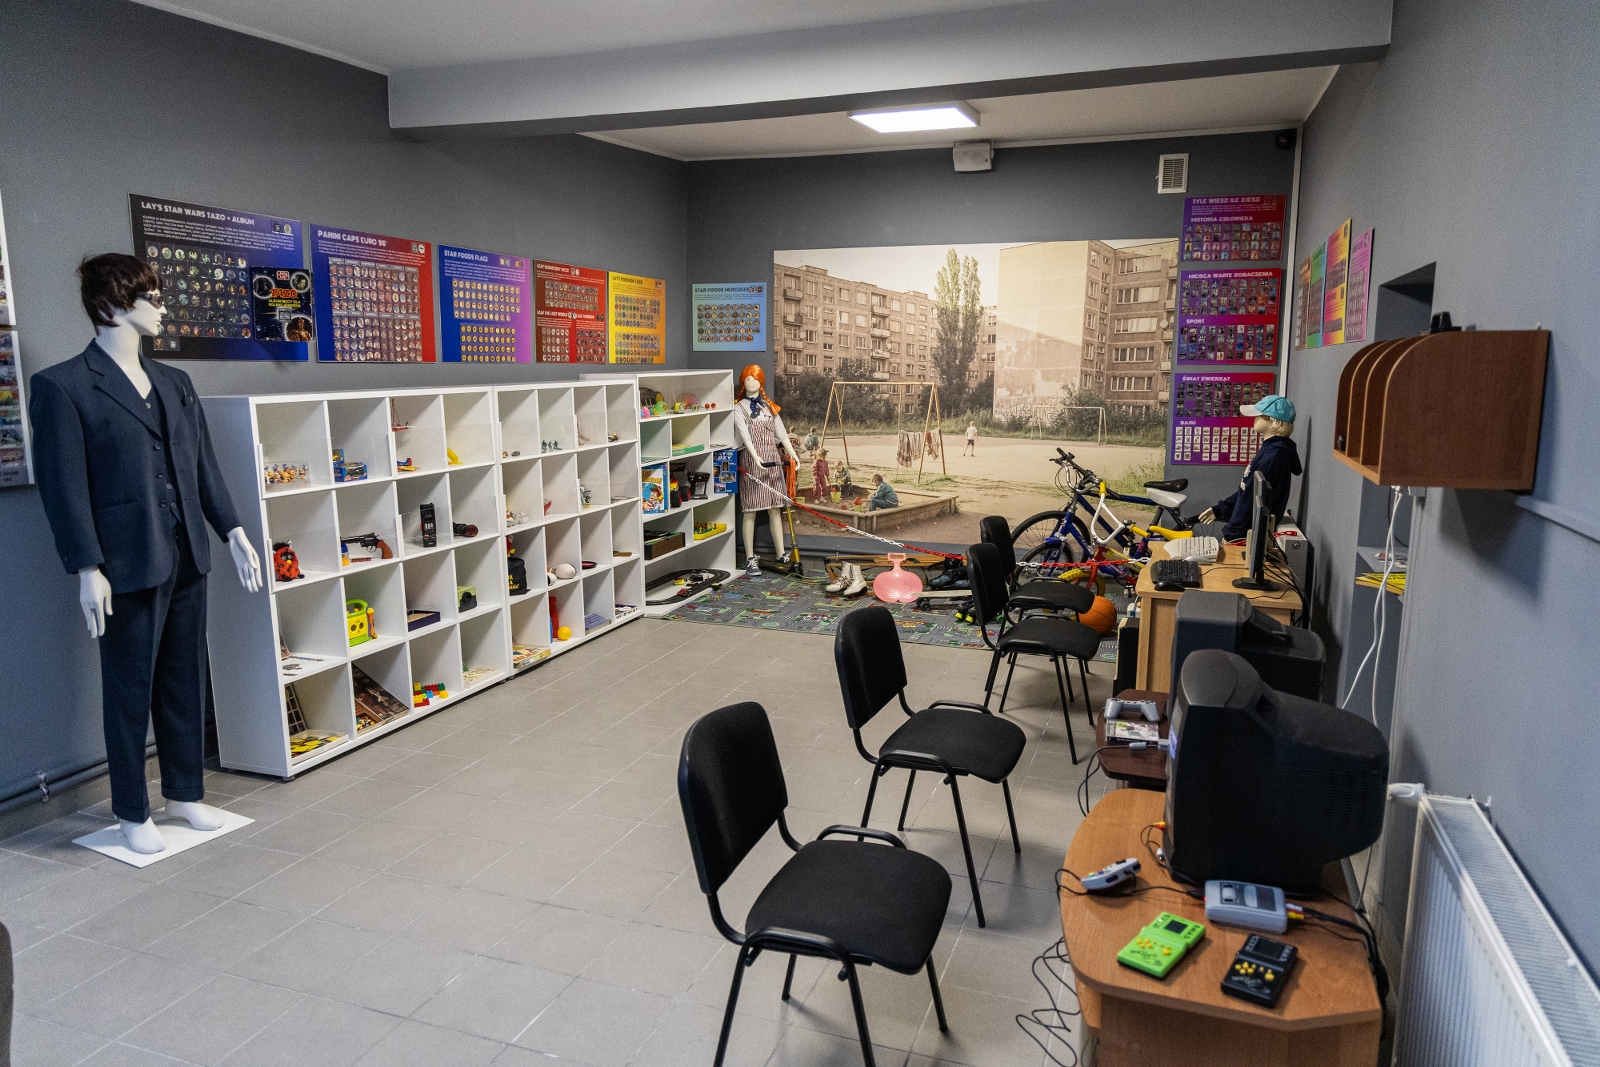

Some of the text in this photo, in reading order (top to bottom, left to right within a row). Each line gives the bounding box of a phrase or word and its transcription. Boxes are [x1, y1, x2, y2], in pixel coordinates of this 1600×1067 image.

[141, 201, 163, 212] LAY'S
[164, 204, 183, 215] STAR
[184, 208, 206, 218] WARS
[207, 212, 226, 221] TAZO
[232, 216, 255, 226] ALBUM
[317, 229, 341, 240] PANINI
[342, 233, 360, 243] CAPS
[360, 236, 377, 246] EURO
[444, 249, 457, 258] STAR
[457, 252, 475, 260] FOODS
[270, 287, 298, 299] TAZO
